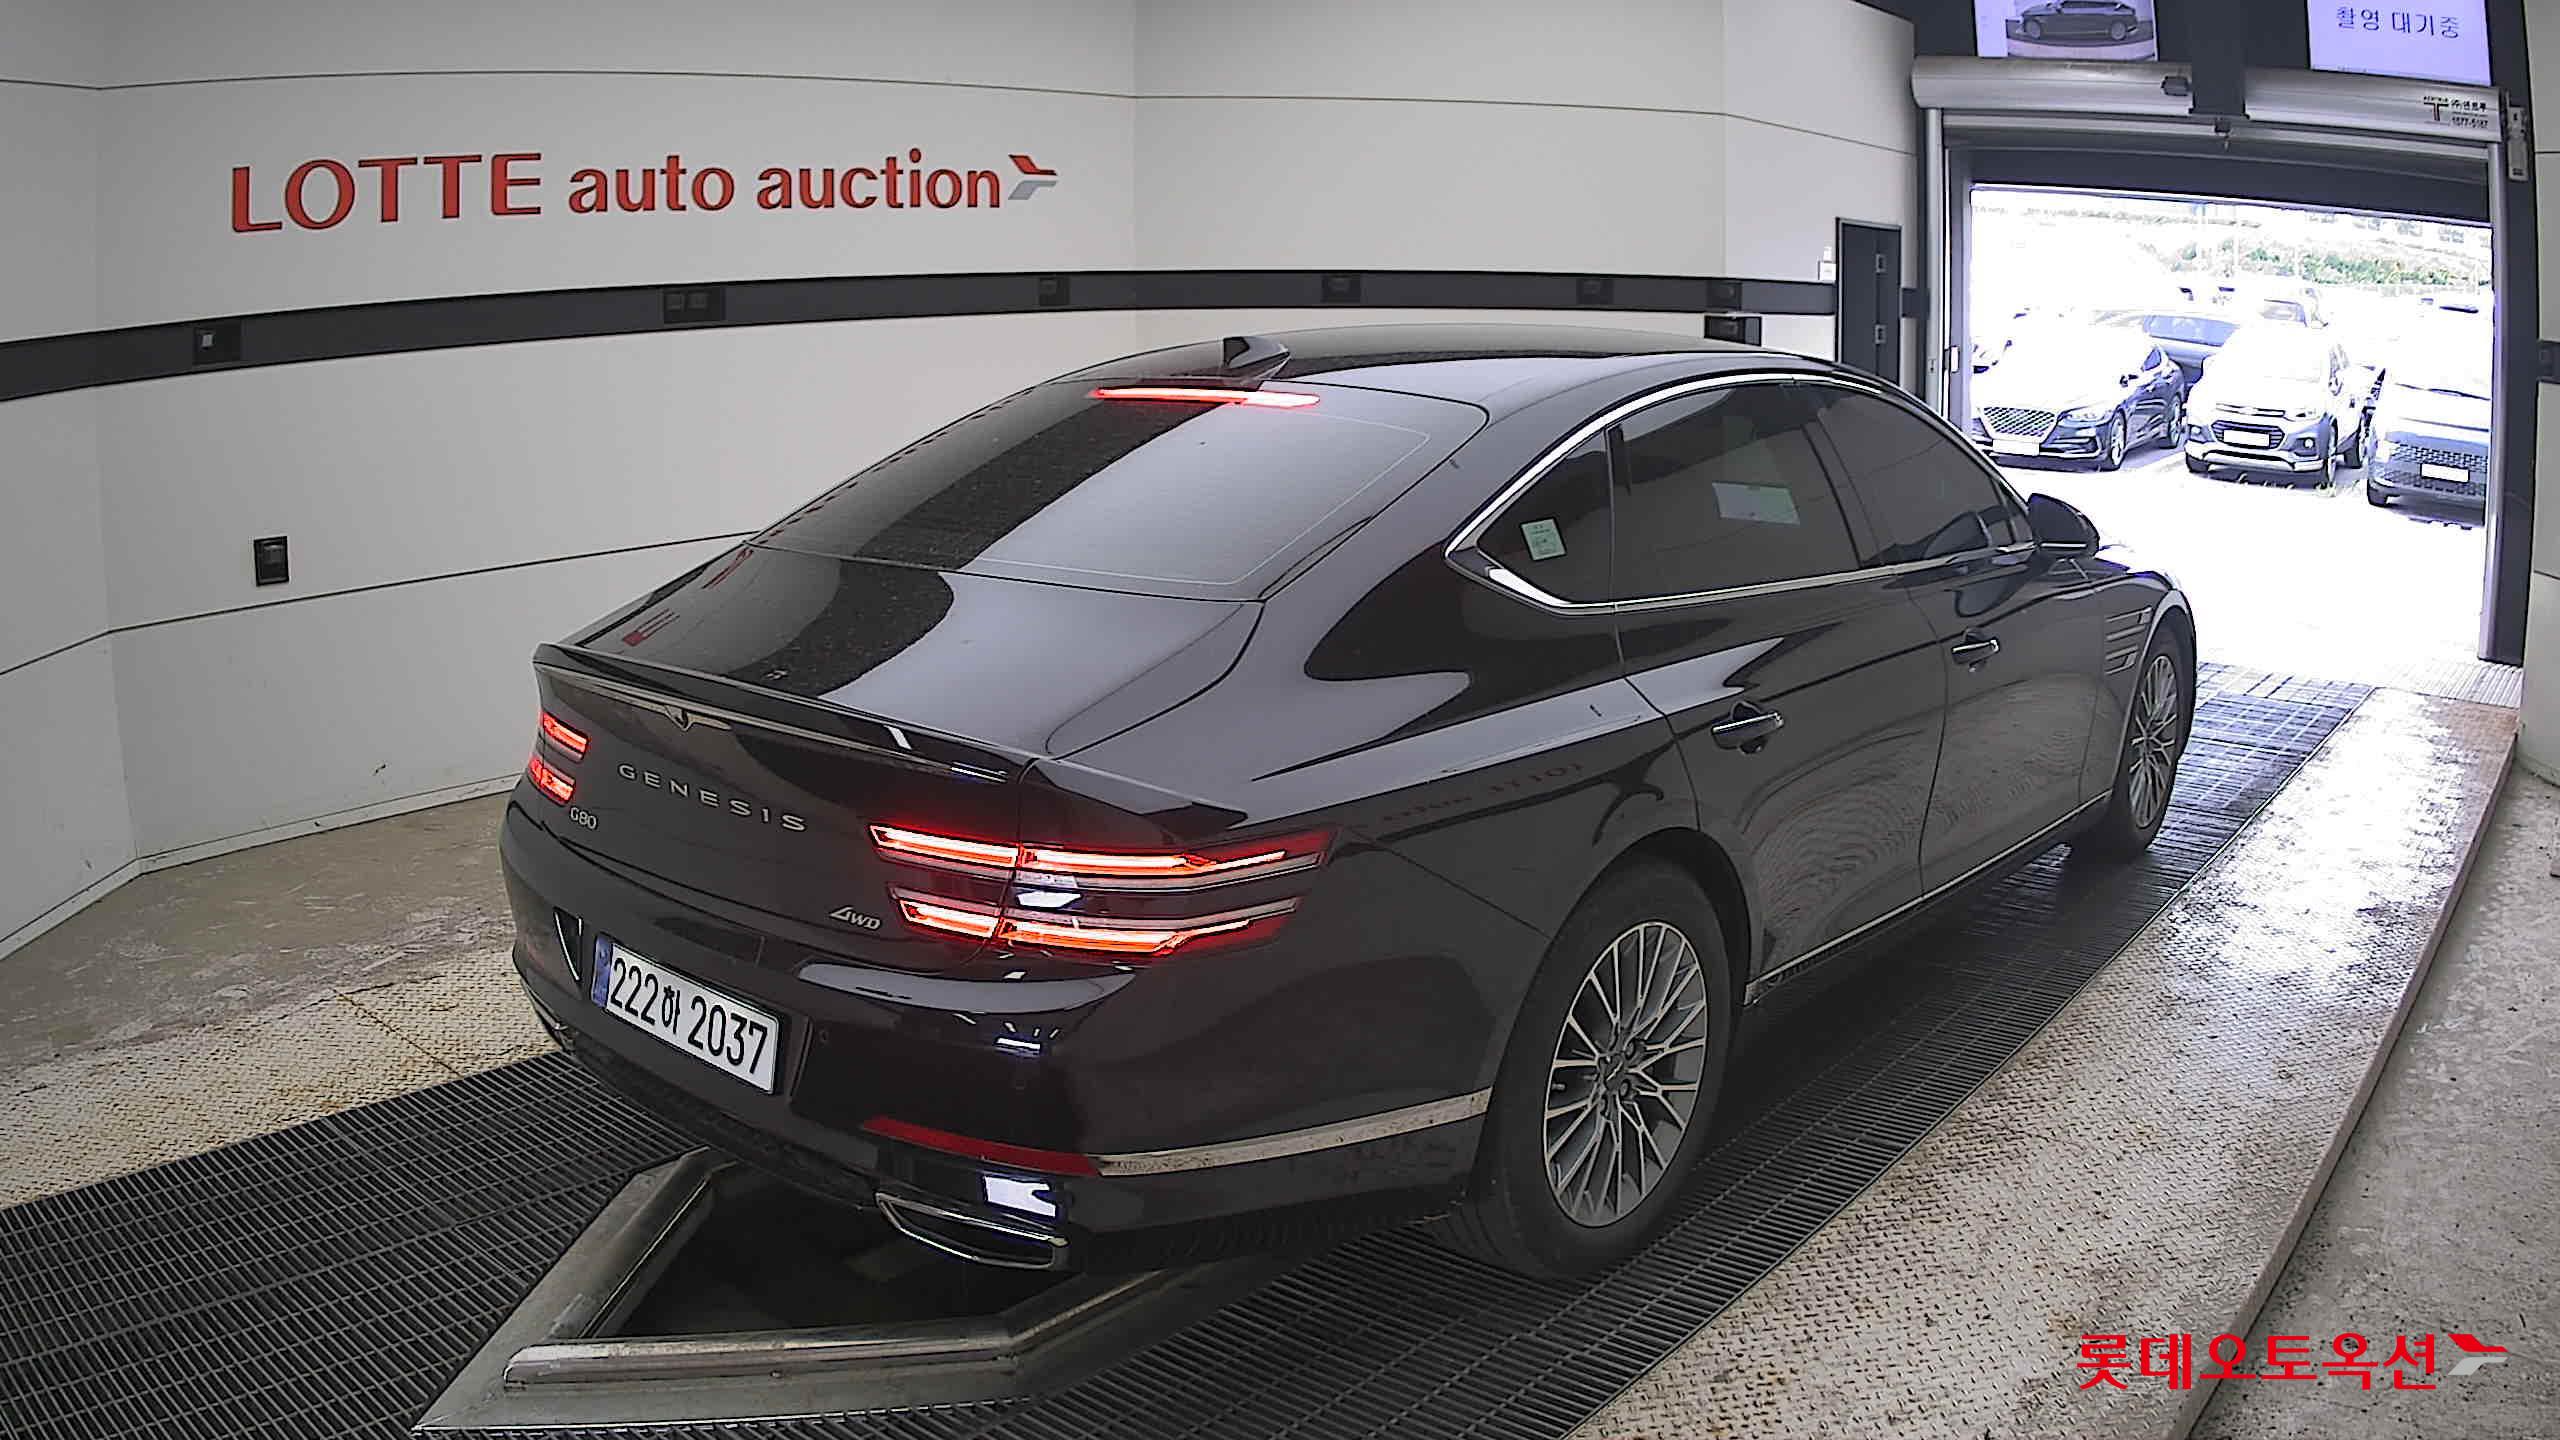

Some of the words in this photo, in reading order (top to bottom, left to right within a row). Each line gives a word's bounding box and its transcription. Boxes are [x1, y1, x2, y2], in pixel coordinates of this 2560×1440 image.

[2337, 6, 2380, 31] 촬영
[2391, 12, 2459, 39] 대기중
[231, 152, 542, 233] LOTTE
[568, 154, 735, 213] auto
[756, 147, 1001, 209] auction
[569, 806, 598, 830] G80
[617, 763, 807, 832] GENESIS
[610, 957, 680, 1035] 222하
[687, 995, 768, 1074] 2037
